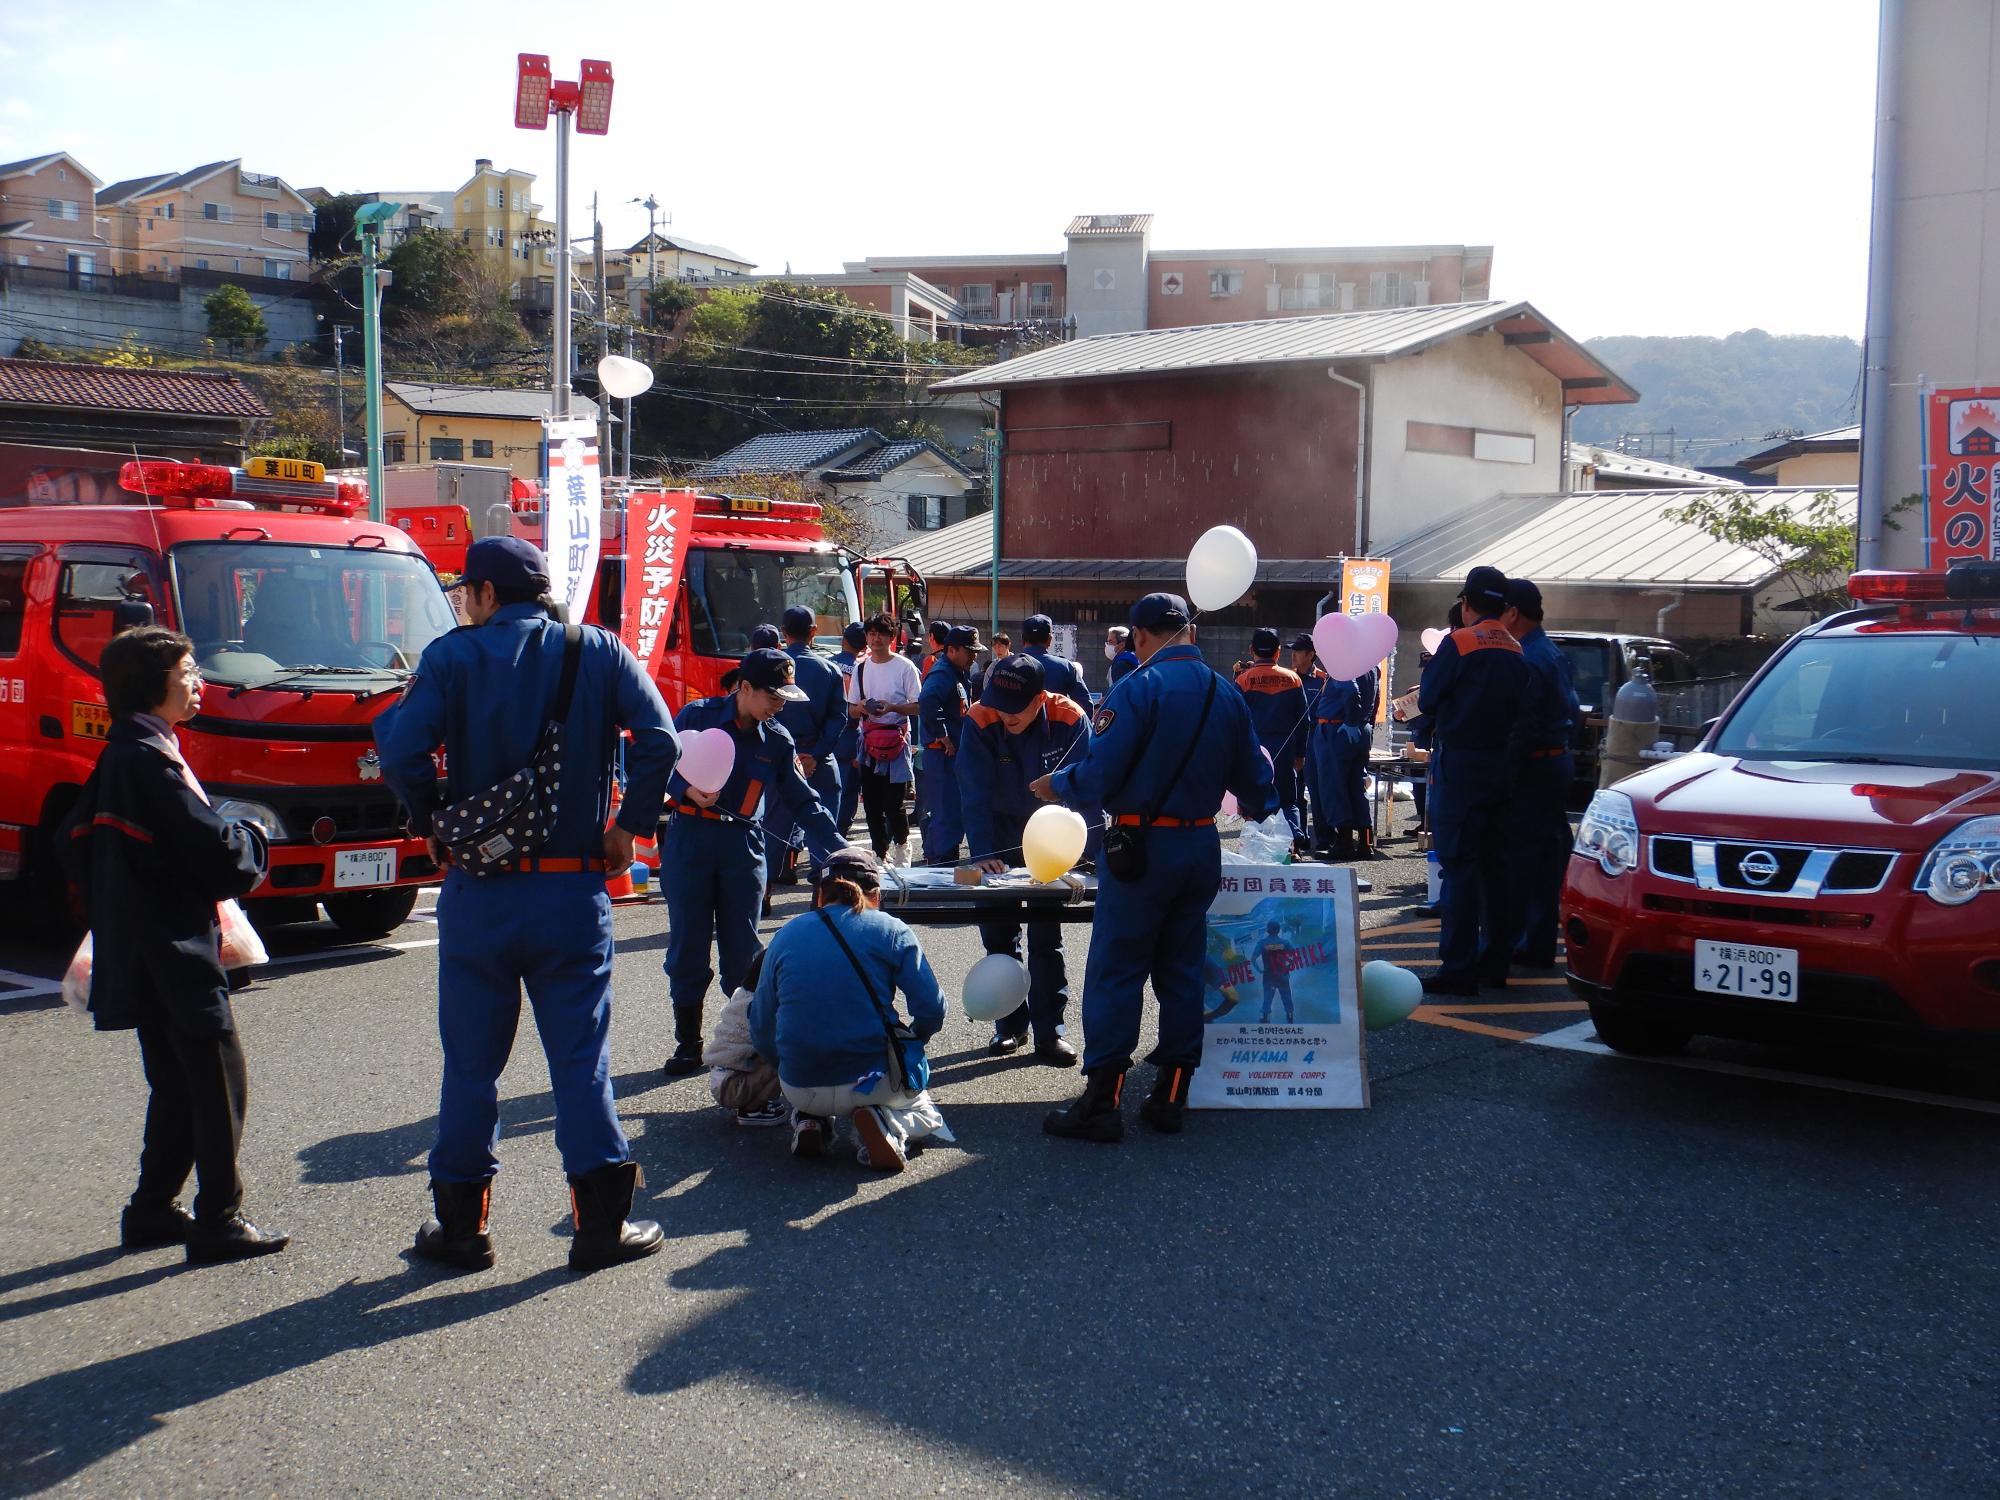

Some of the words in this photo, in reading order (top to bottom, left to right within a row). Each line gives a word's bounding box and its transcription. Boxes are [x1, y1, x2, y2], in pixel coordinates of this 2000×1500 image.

[265, 460, 315, 479] 葉山町
[1943, 462, 1987, 567] 火の
[637, 503, 679, 672] 火災予防運
[1742, 863, 1775, 873] NISSAN
[1220, 877, 1336, 894] 防団員募集
[1720, 947, 1774, 965] 横浜800
[1702, 968, 1712, 981] ち
[1717, 963, 1792, 997] 21-99
[1230, 1050, 1289, 1064] HAYAMA
[1303, 1050, 1315, 1064] 4
[1222, 1071, 1241, 1080] FIRE
[1248, 1071, 1294, 1080] VOLUNTEER
[1300, 1071, 1327, 1080] CORPS
